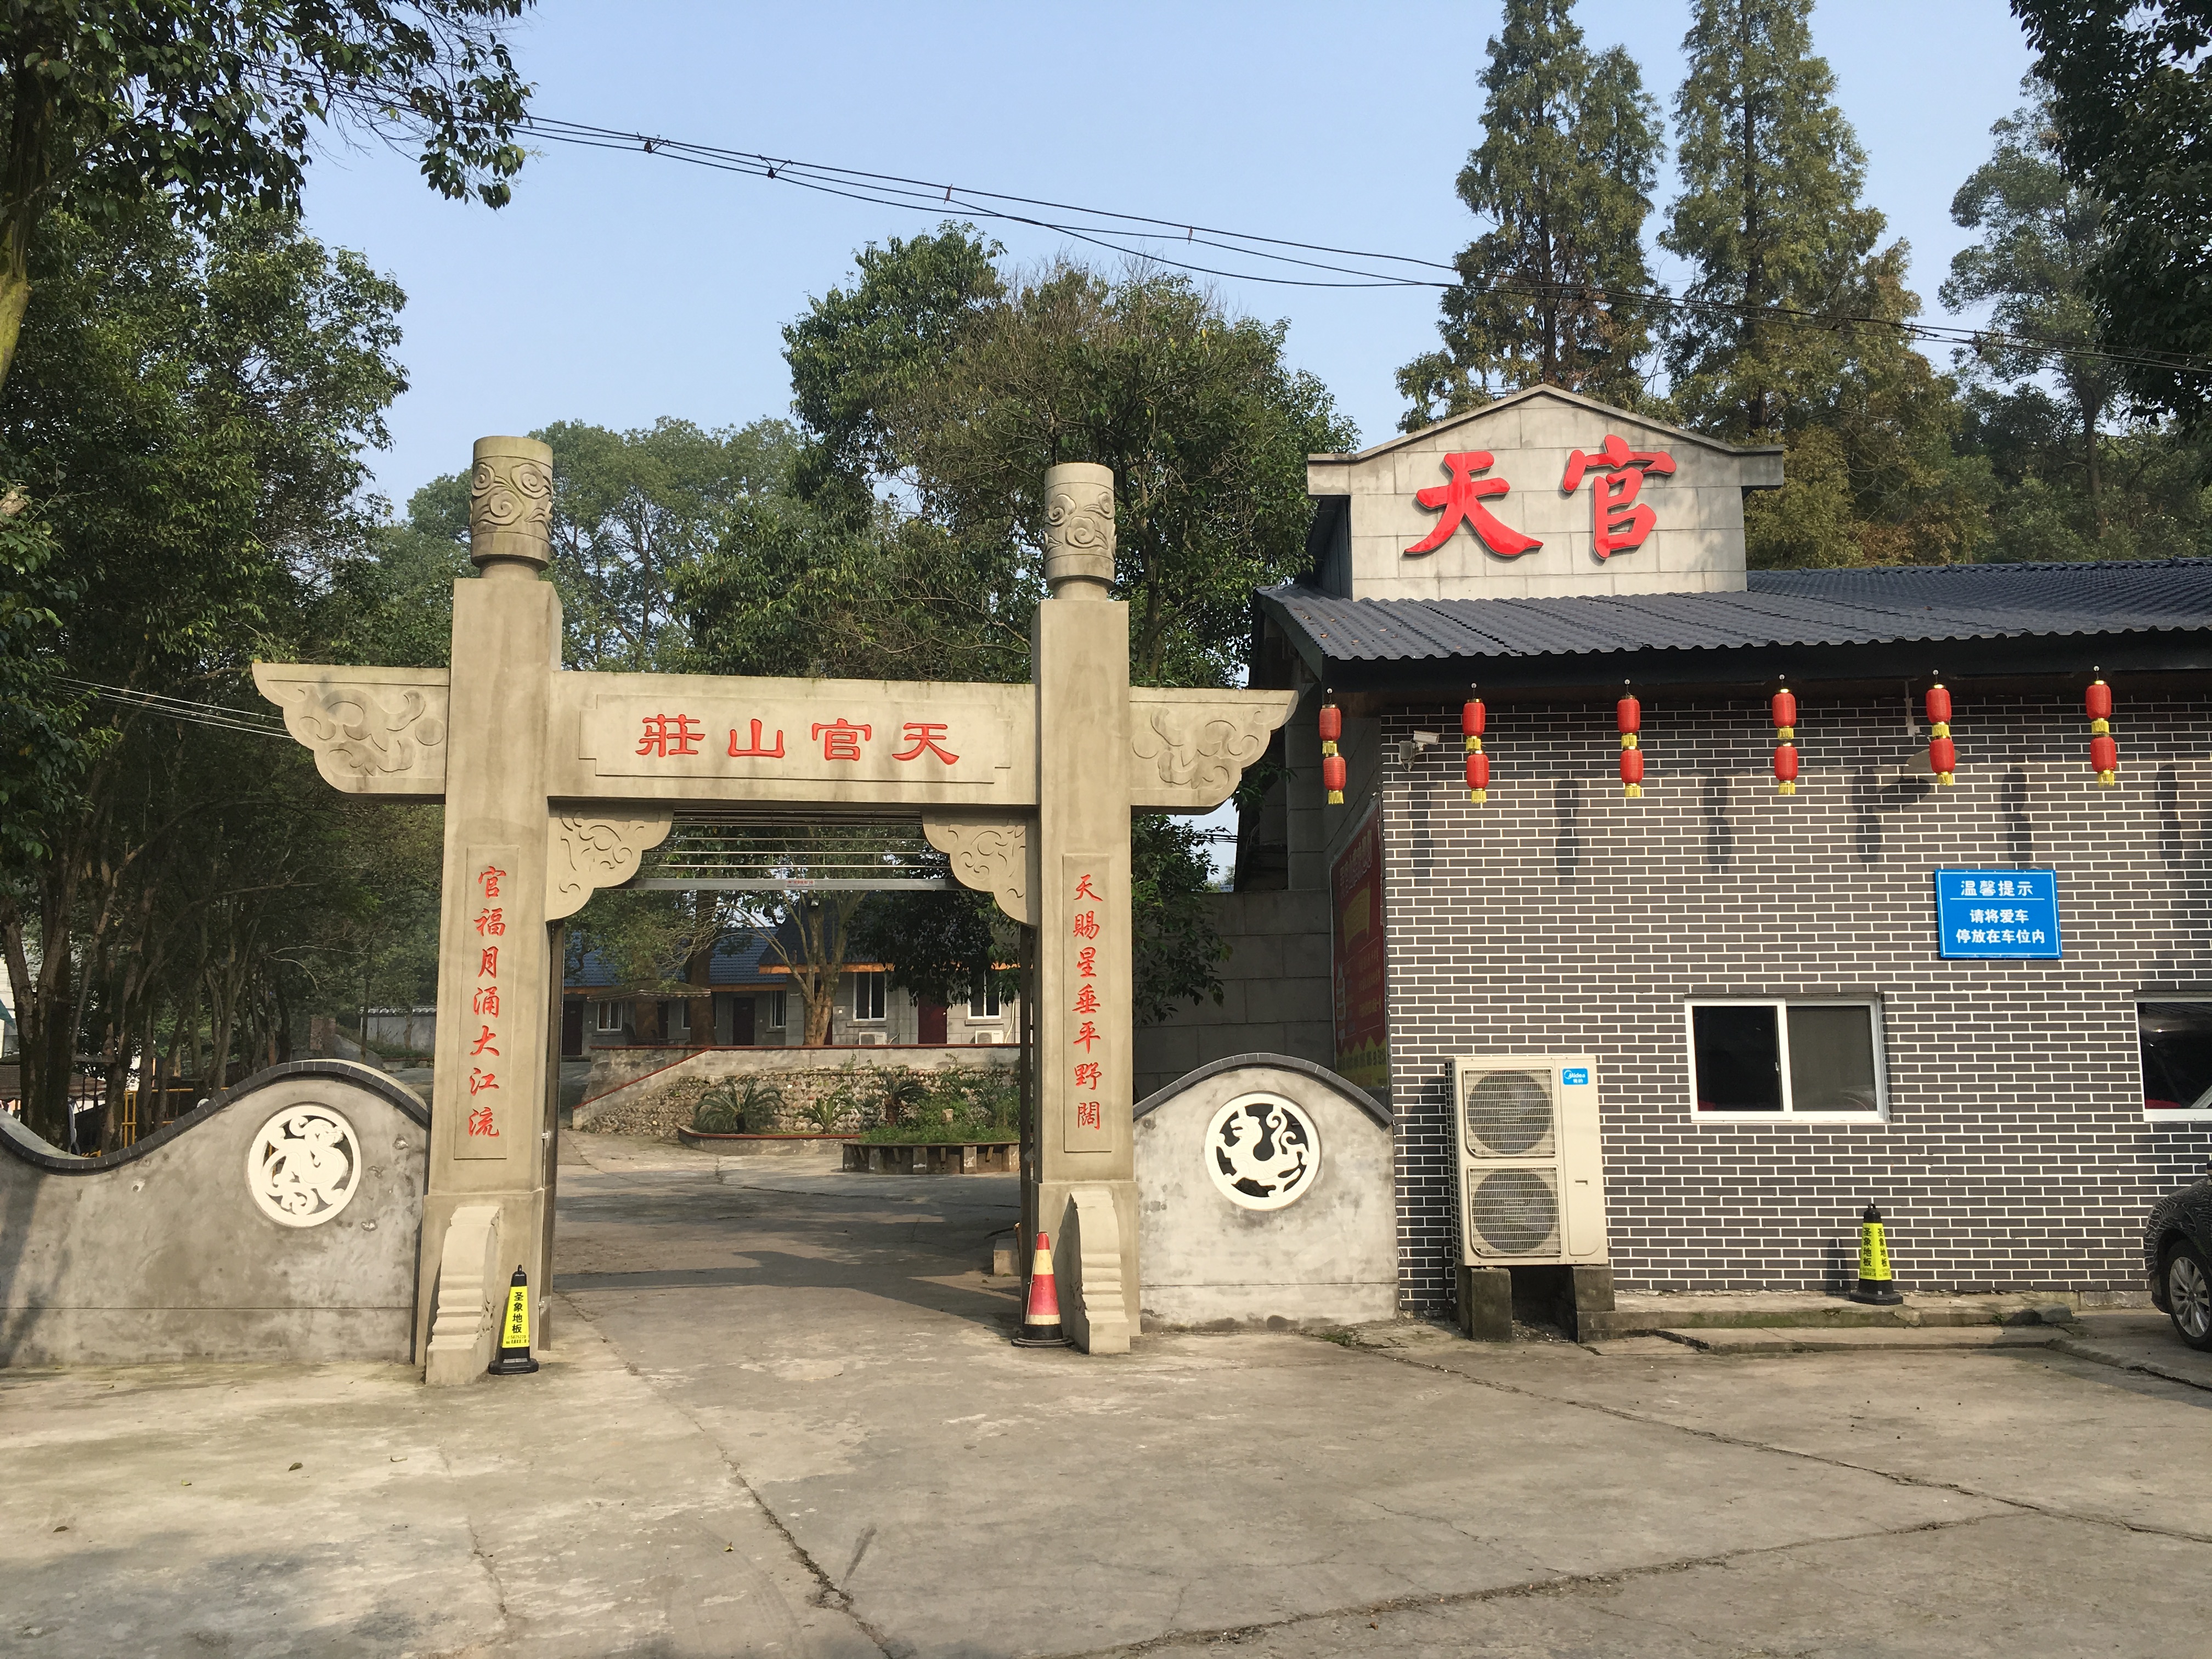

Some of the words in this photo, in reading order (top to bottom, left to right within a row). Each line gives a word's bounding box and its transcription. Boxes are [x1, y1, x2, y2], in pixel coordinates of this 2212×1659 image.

[1404, 434, 1677, 559] 天官
[1961, 880, 2033, 896] 温馨提示
[1970, 909, 2029, 923] 请将爱车
[1956, 929, 2045, 944] 停放在车位内
[1863, 1227, 1872, 1267] 圣象地板
[512, 1292, 524, 1334] 圣象地板
